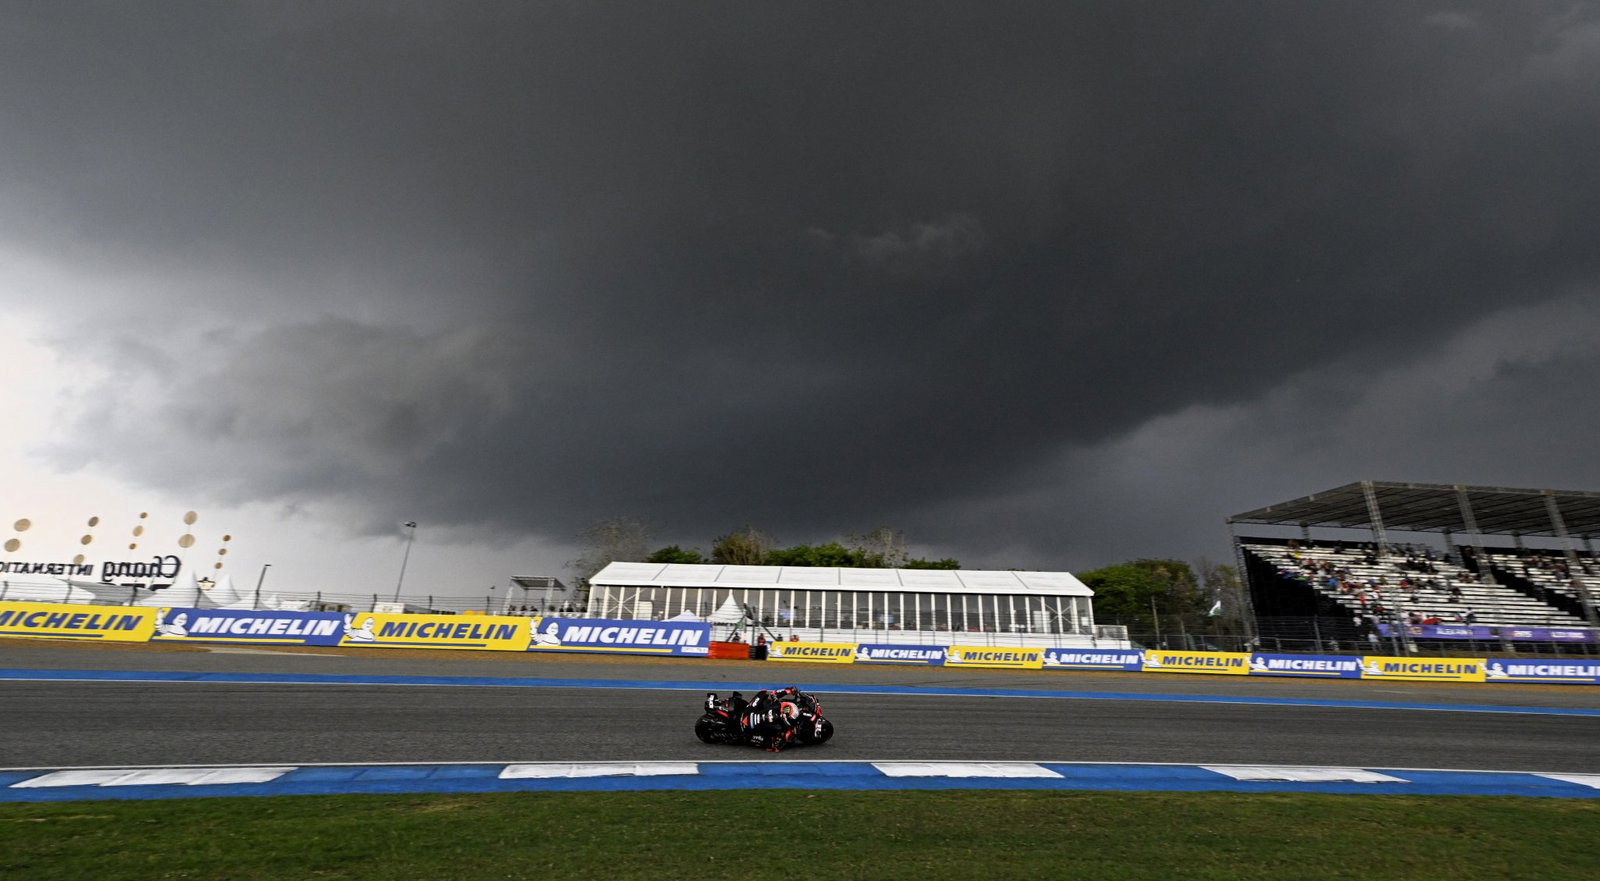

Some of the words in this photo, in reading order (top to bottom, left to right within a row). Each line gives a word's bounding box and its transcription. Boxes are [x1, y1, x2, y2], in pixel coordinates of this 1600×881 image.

[190, 617, 338, 635] MICHELIN
[378, 621, 518, 640] MICHELIN
[561, 626, 703, 646] MICHELIN
[784, 646, 852, 658] MICHELIN
[870, 649, 943, 659] MICHELIN
[963, 652, 1038, 662] MICHELIN
[1059, 653, 1138, 664] MICHELIN
[1162, 656, 1244, 667] MICHELIN
[1268, 659, 1356, 670] MICHELIN
[1384, 663, 1477, 673] MICHELIN
[1507, 665, 1600, 676] MICHELI
